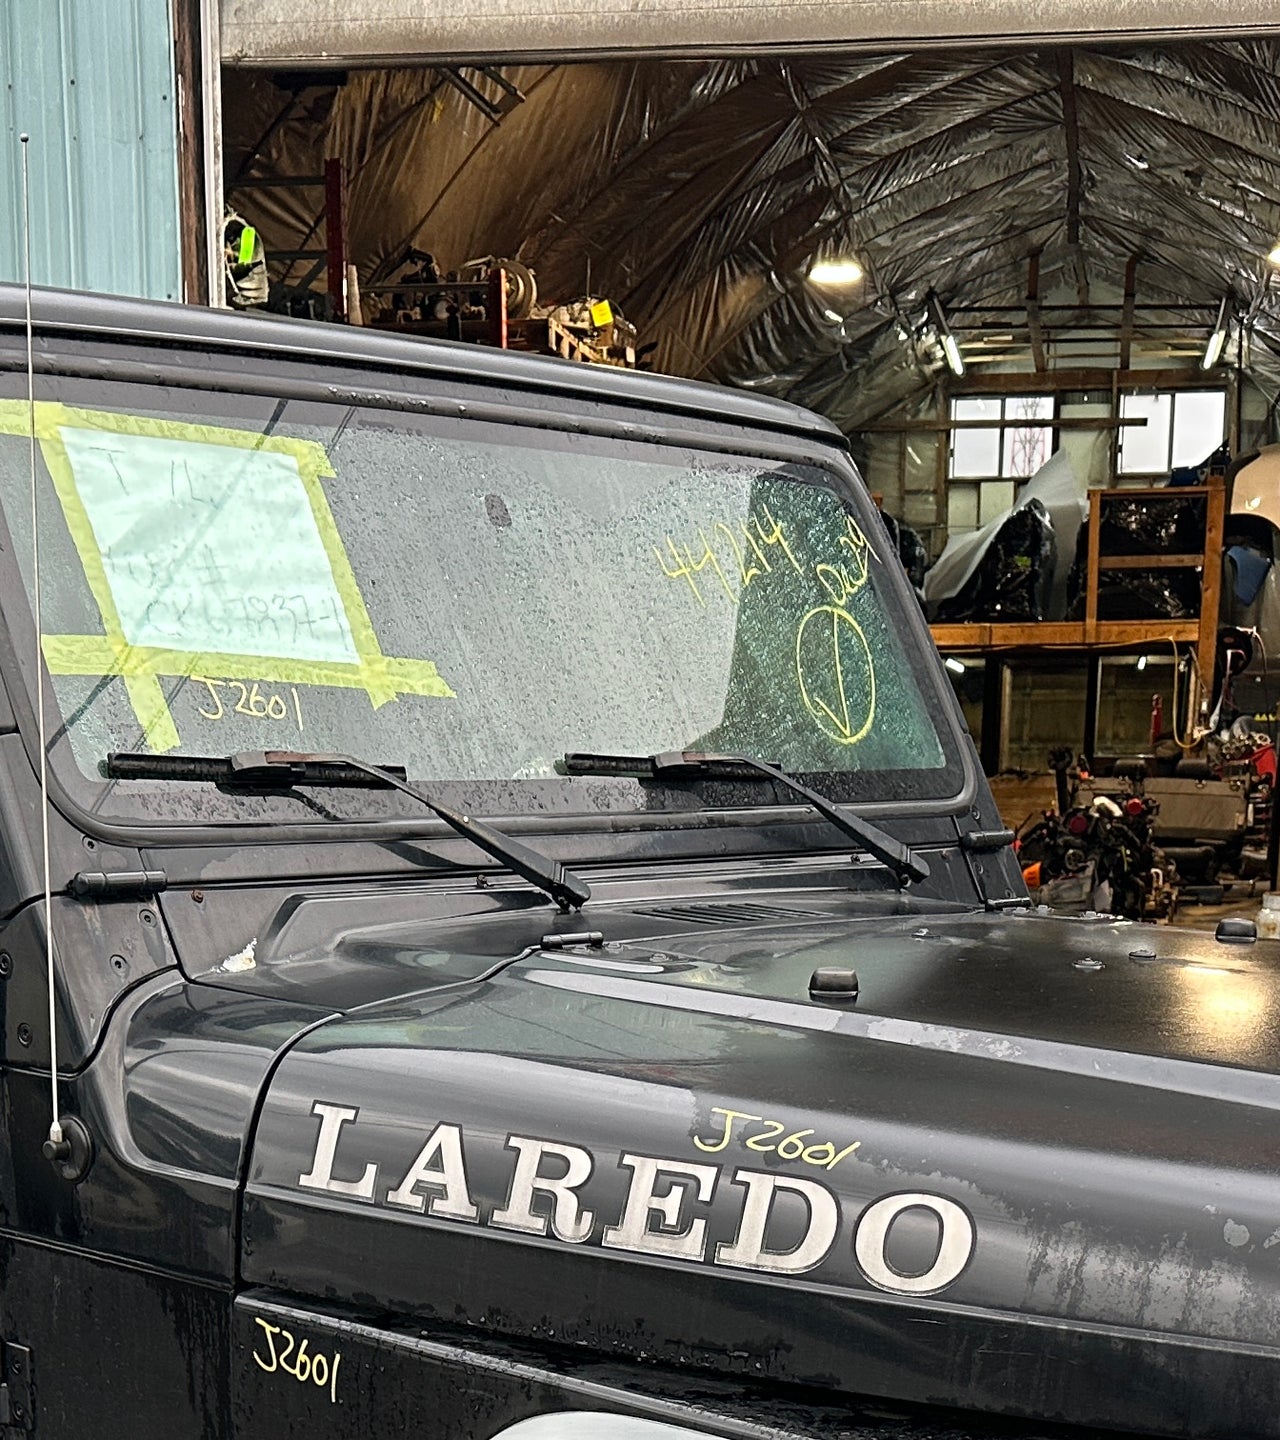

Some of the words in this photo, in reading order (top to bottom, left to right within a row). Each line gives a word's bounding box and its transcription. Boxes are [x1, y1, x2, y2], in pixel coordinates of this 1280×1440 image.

[191, 676, 304, 731] J2601
[693, 1107, 863, 1172] J2601
[297, 1101, 978, 1296] LAREDO
[253, 1318, 342, 1402] J2601
